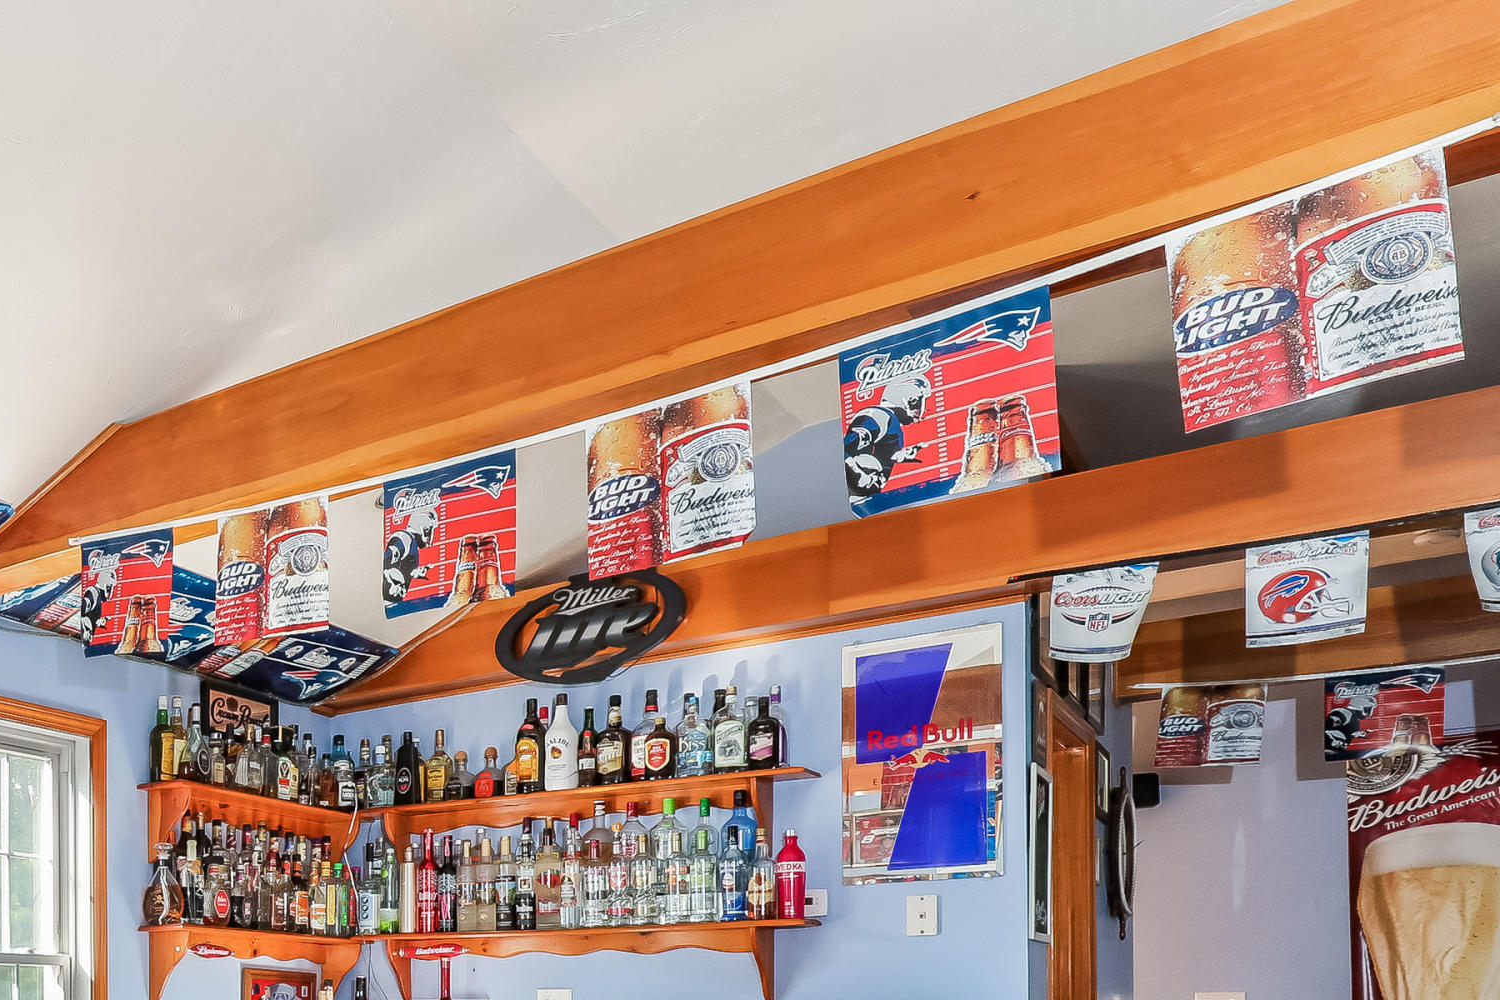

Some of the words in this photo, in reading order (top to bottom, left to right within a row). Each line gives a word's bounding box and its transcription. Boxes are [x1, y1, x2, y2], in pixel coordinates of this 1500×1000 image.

[1185, 286, 1276, 327] BUD
[1175, 301, 1288, 351] LIGHT
[857, 347, 932, 392] Patriots
[592, 475, 648, 498] BUD
[393, 488, 442, 518] Patriots
[588, 487, 656, 515] LIGHT
[1295, 544, 1338, 559] LIGHT
[220, 563, 257, 581] BUD
[553, 585, 637, 610] Miller
[1054, 591, 1099, 607] Coors
[1098, 589, 1151, 605] LIGHT
[1089, 620, 1109, 630] NFL
[211, 697, 241, 725] Crown
[1164, 717, 1199, 725] BUD
[867, 725, 917, 751] Red
[922, 718, 973, 744] Bull
[1348, 767, 1500, 832] Budweis
[1384, 819, 1405, 830] The
[1407, 810, 1438, 823] Great
[1440, 790, 1496, 813] American
